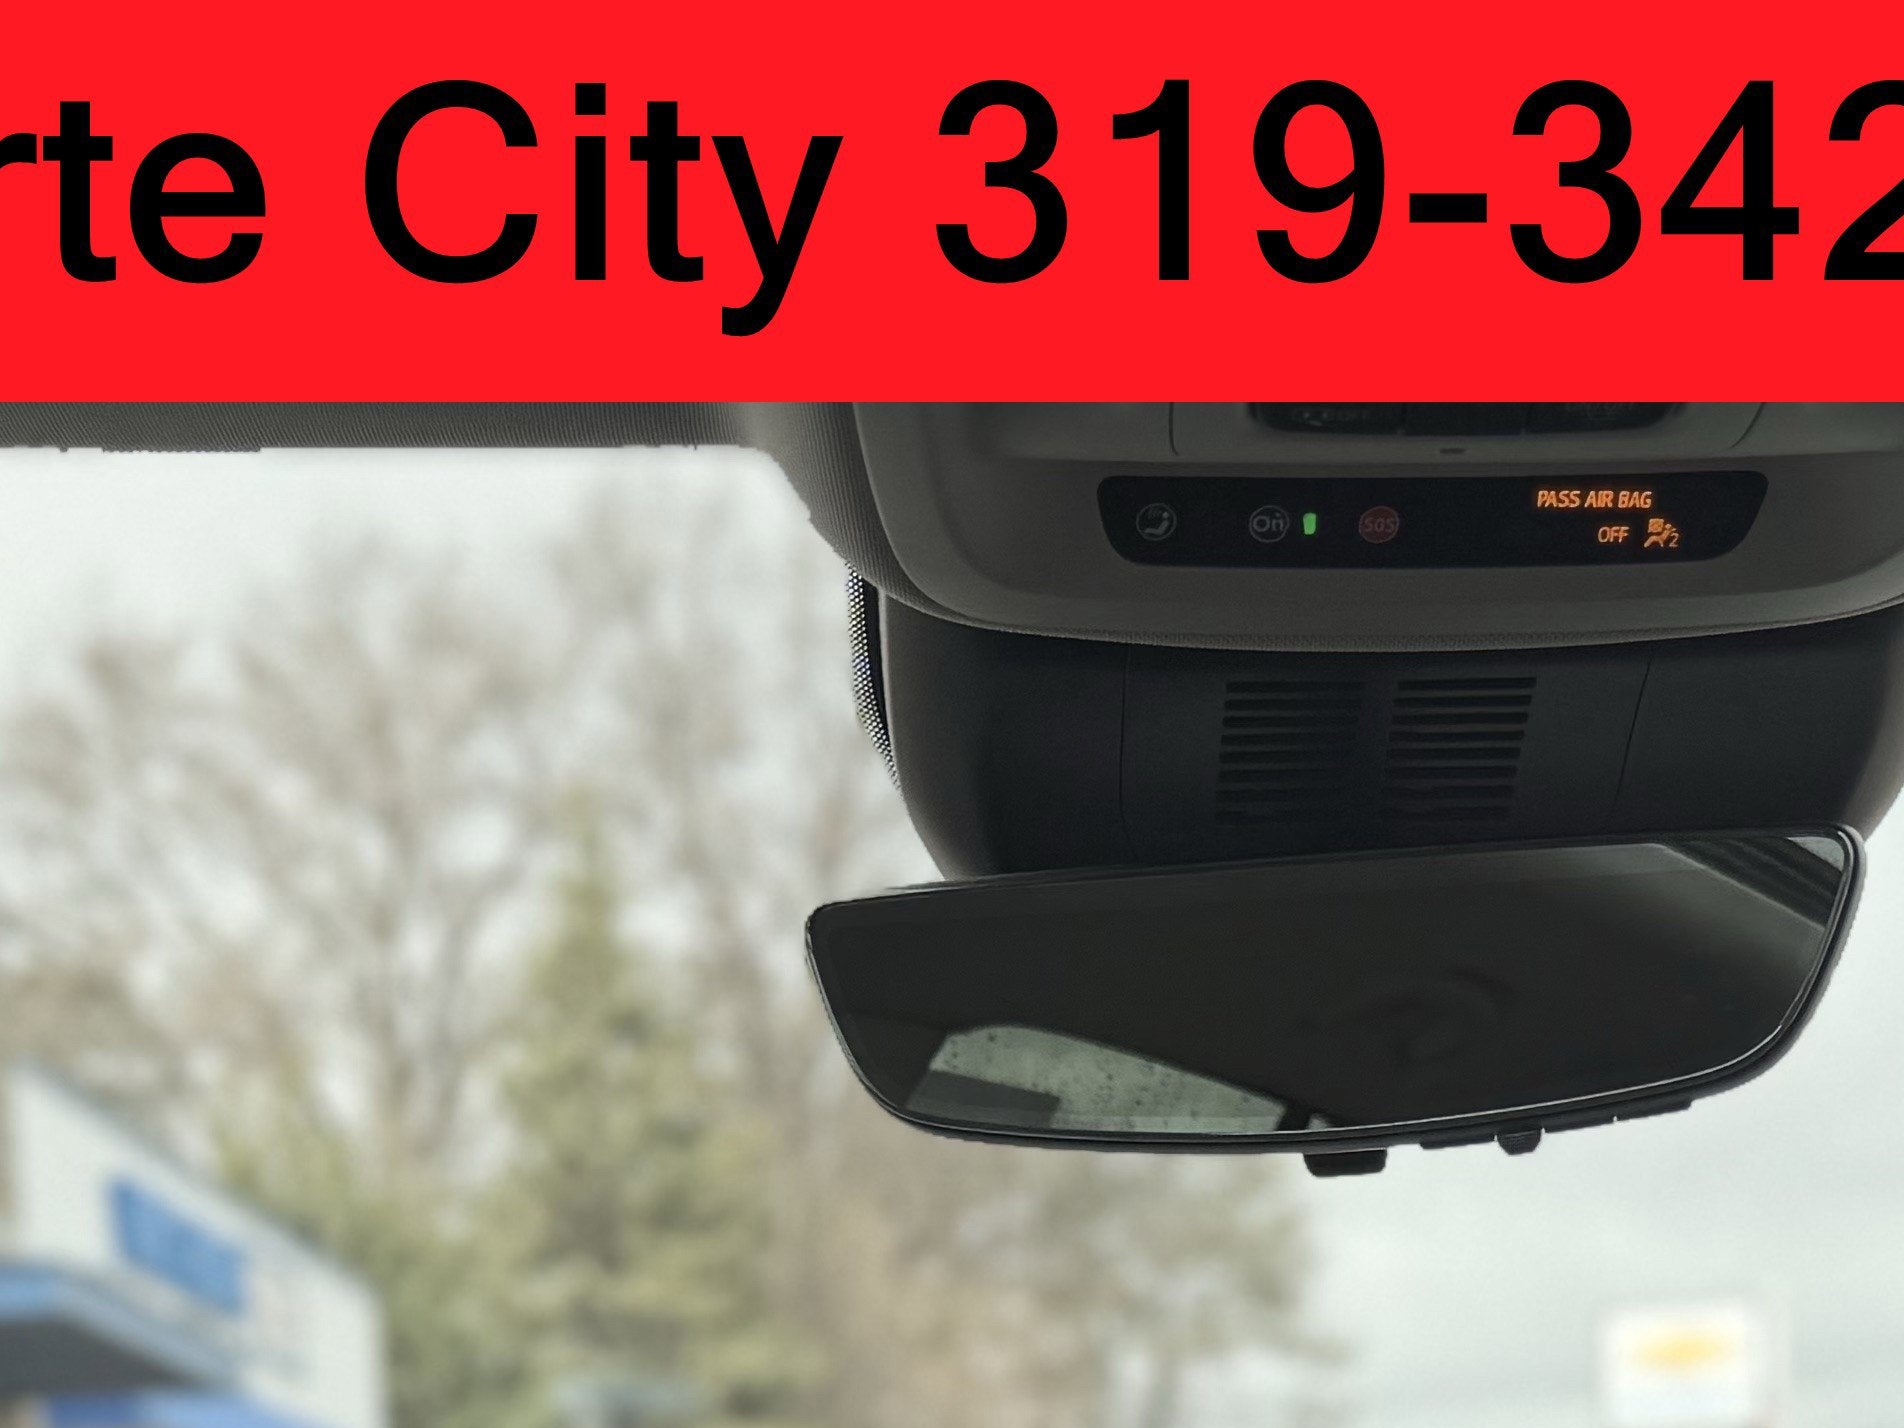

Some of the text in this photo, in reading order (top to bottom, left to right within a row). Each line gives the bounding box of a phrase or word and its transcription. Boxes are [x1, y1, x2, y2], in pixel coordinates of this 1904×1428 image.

[1537, 490, 1652, 509] PASS AIR BAG
[1598, 526, 1630, 543] OFF
